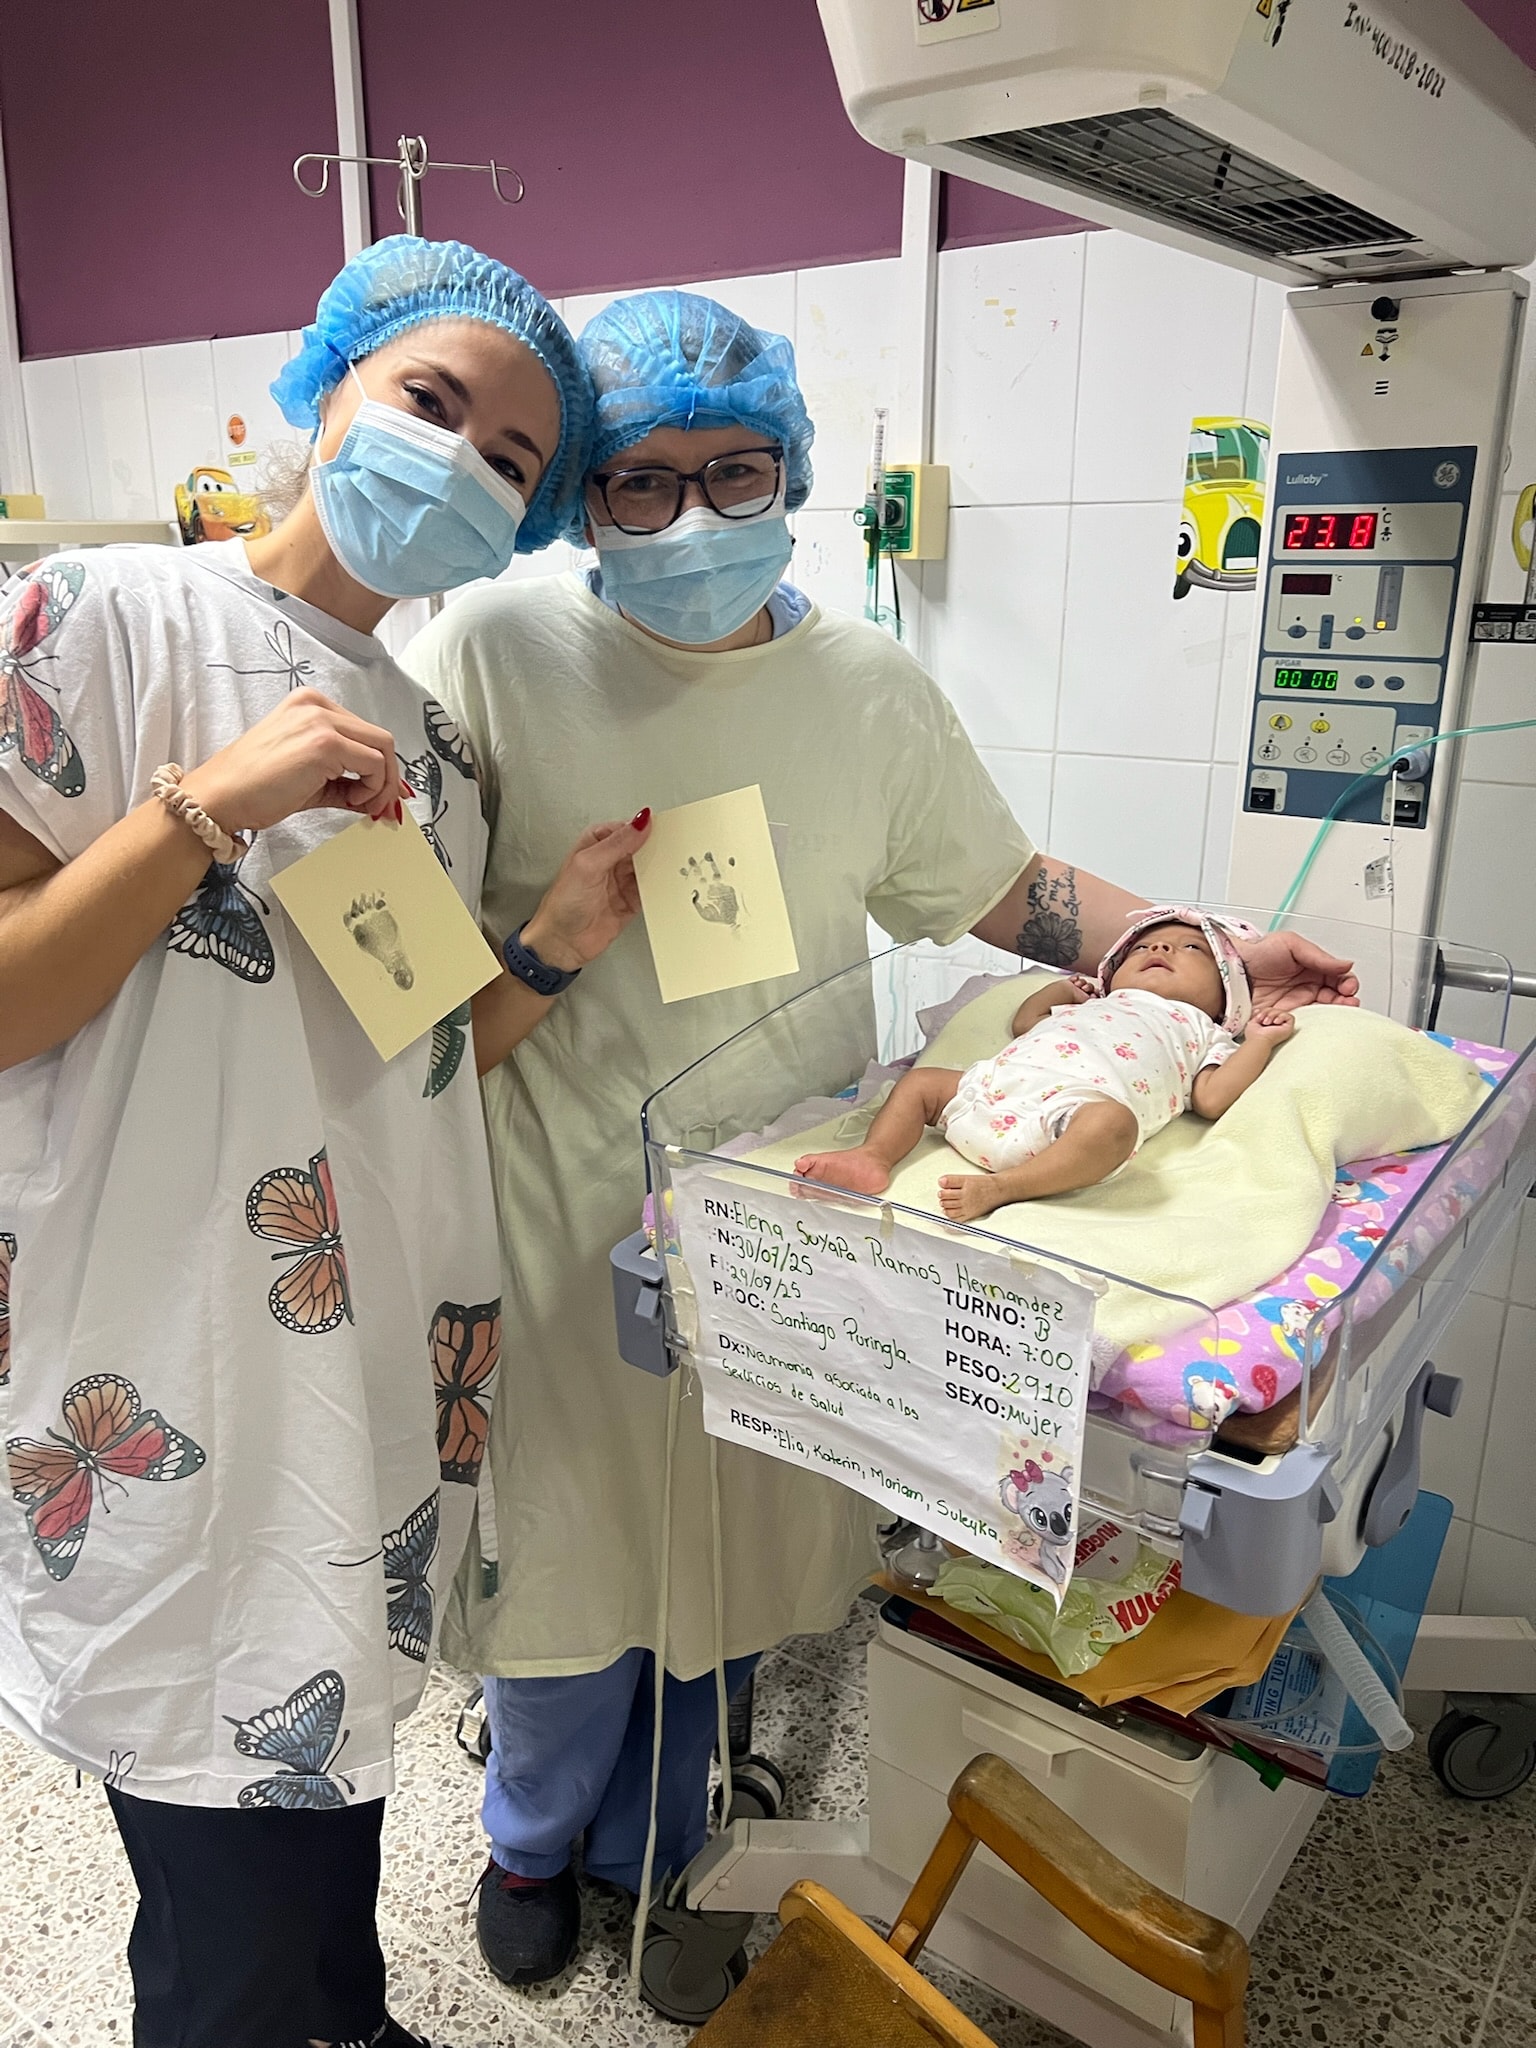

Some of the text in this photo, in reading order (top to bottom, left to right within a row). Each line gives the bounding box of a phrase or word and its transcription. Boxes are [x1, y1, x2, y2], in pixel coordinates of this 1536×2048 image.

[1286, 515, 1375, 548] 23.8
[770, 1302, 837, 1351] Santiago
[942, 1287, 1051, 1342] TURNO: B
[945, 1318, 1011, 1357] HORA:
[791, 1382, 804, 1402] de
[1269, 1651, 1290, 1683] TUBE
